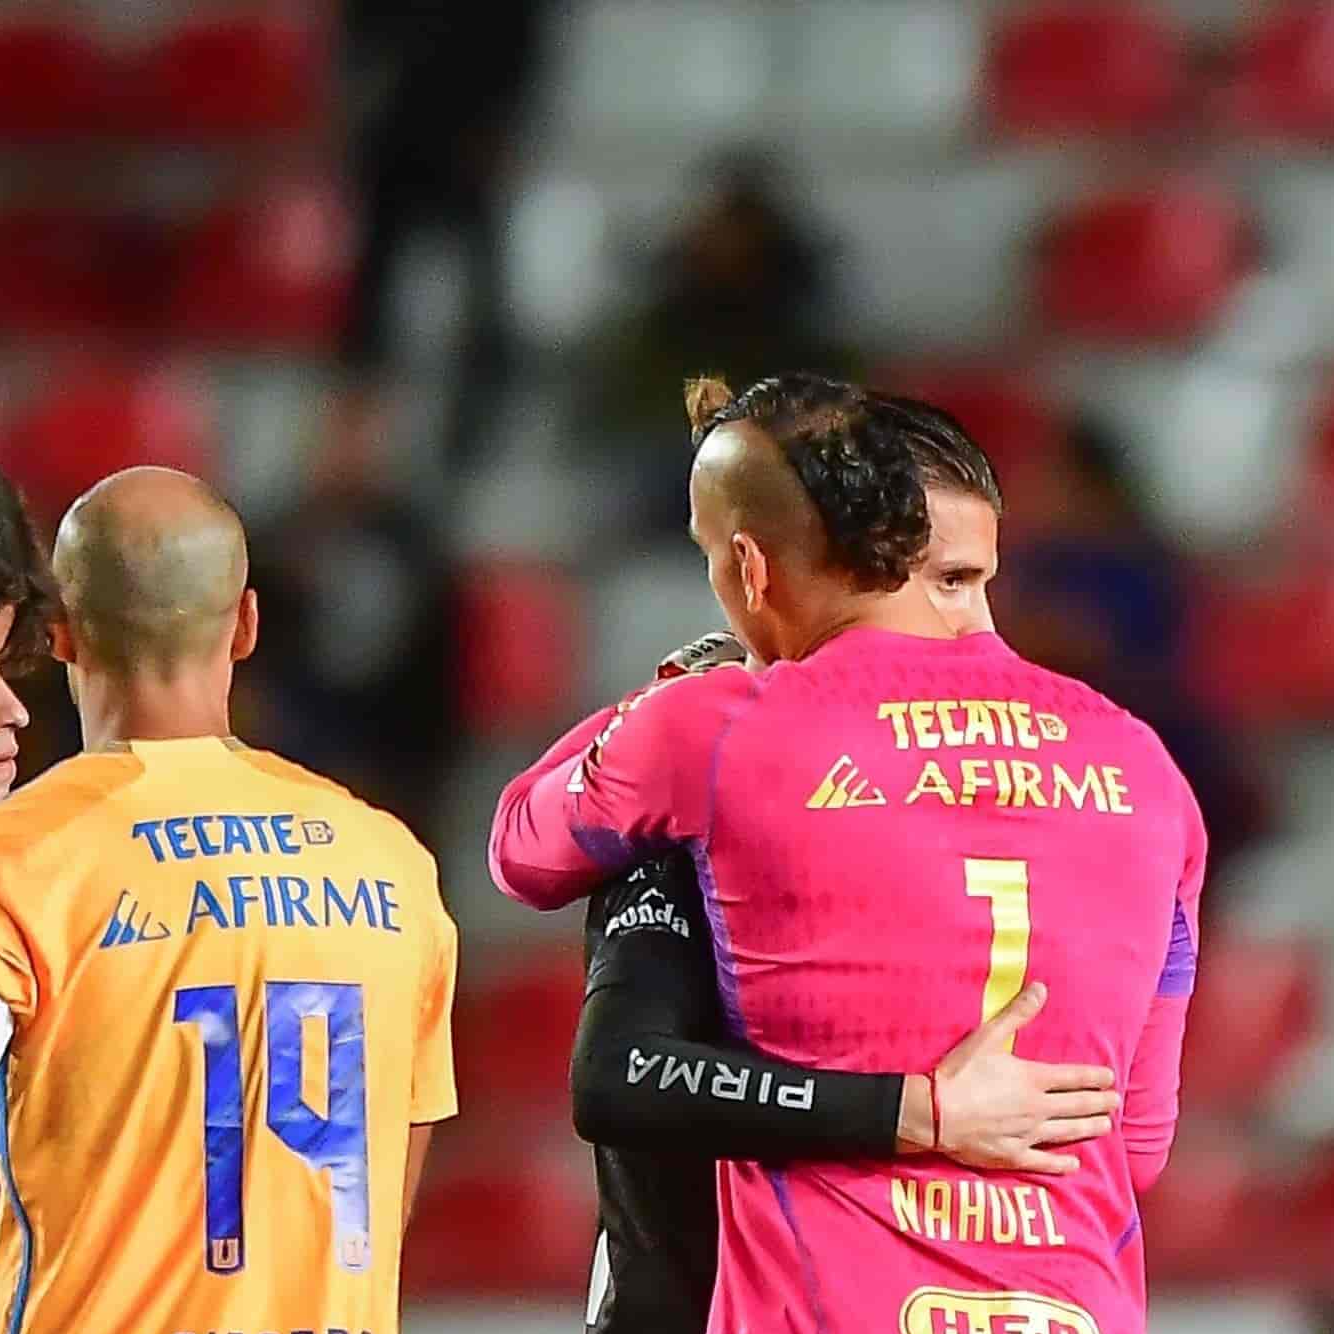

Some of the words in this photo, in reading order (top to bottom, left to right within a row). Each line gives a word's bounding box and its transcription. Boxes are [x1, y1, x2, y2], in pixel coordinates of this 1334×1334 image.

[878, 700, 1040, 749] TECATE
[905, 759, 1133, 814] AFIRME
[133, 814, 302, 864] TECATE
[186, 876, 402, 935] AFIRME
[605, 901, 690, 938] onda
[964, 857, 1030, 1025] 1
[627, 1048, 815, 1110] PIRMA
[172, 981, 371, 1273] 19
[891, 1177, 1066, 1247] NAHUEL
